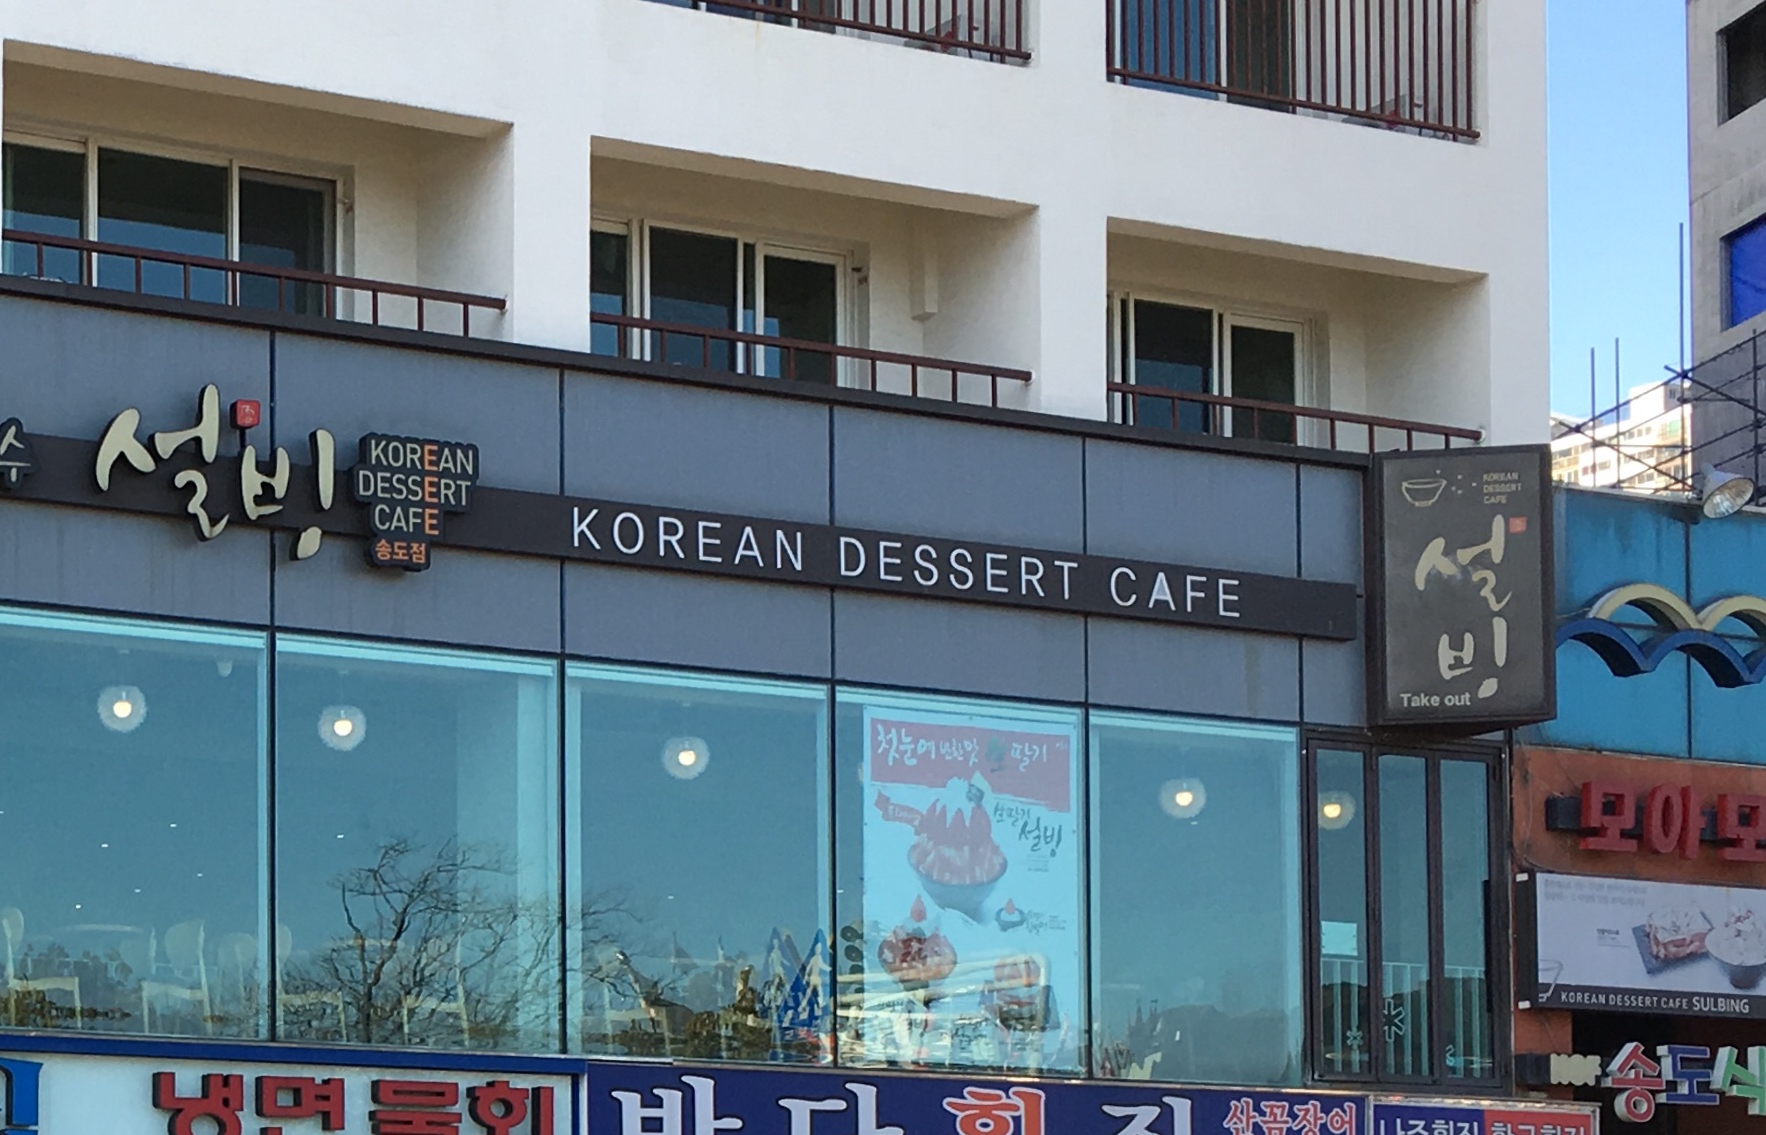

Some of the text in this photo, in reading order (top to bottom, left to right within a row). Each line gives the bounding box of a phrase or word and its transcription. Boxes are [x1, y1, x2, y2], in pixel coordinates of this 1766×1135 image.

[95, 384, 334, 560] 설빙
[370, 439, 474, 475] KOREAN
[359, 470, 471, 506] DESSERT
[374, 503, 439, 535] CAFE
[375, 538, 426, 563] 송도점
[572, 506, 1241, 618] KOREAN DESSERT CAFE
[1415, 514, 1513, 699] 설빙
[1400, 692, 1471, 708] Take out
[1018, 816, 1062, 857] 설빙
[1561, 991, 1750, 1013] KOREAN DESSERT CAFE SULBING
